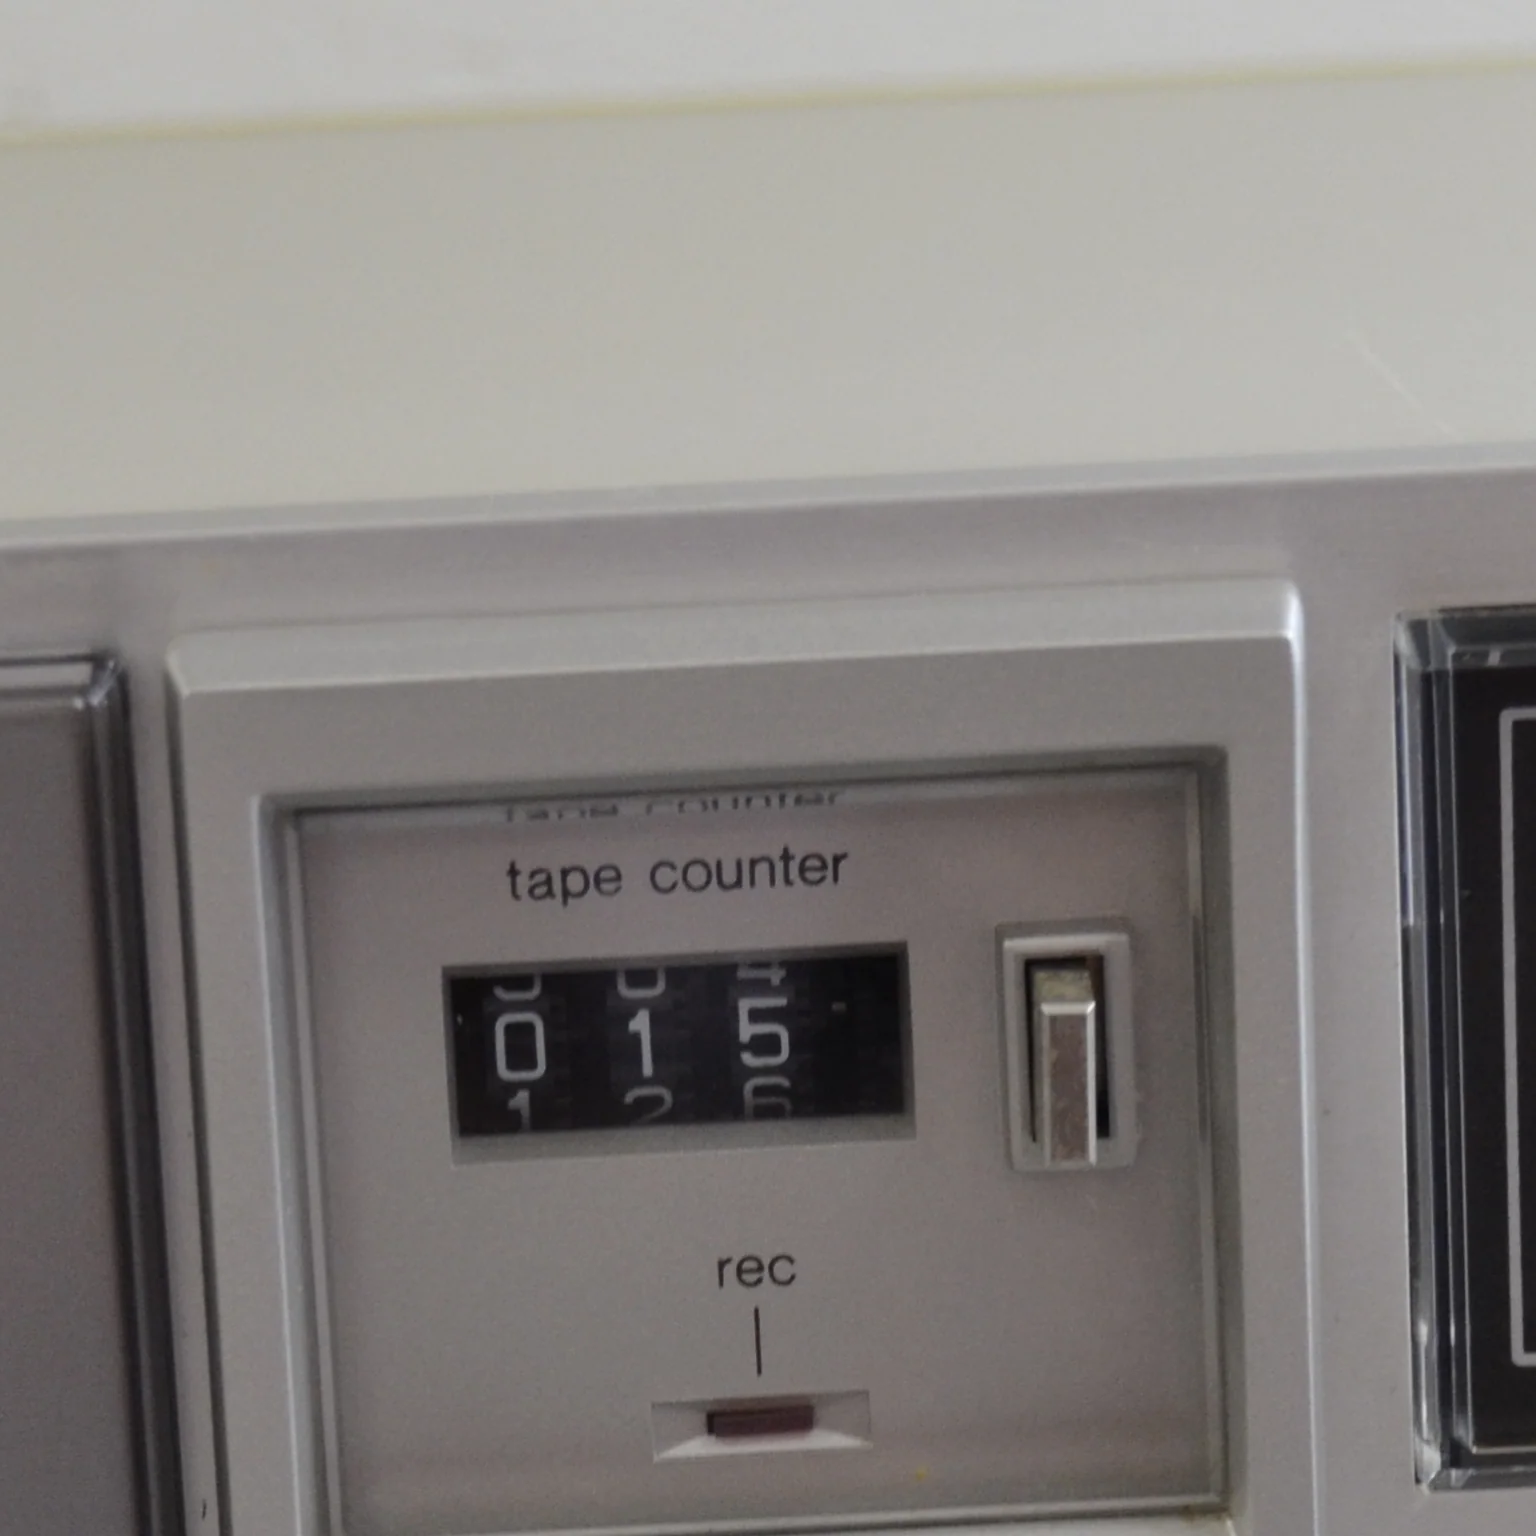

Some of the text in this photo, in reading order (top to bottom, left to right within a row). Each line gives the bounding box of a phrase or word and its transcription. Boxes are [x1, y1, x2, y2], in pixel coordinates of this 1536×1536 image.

[505, 844, 850, 908] tape counter
[716, 1253, 798, 1289] rec
